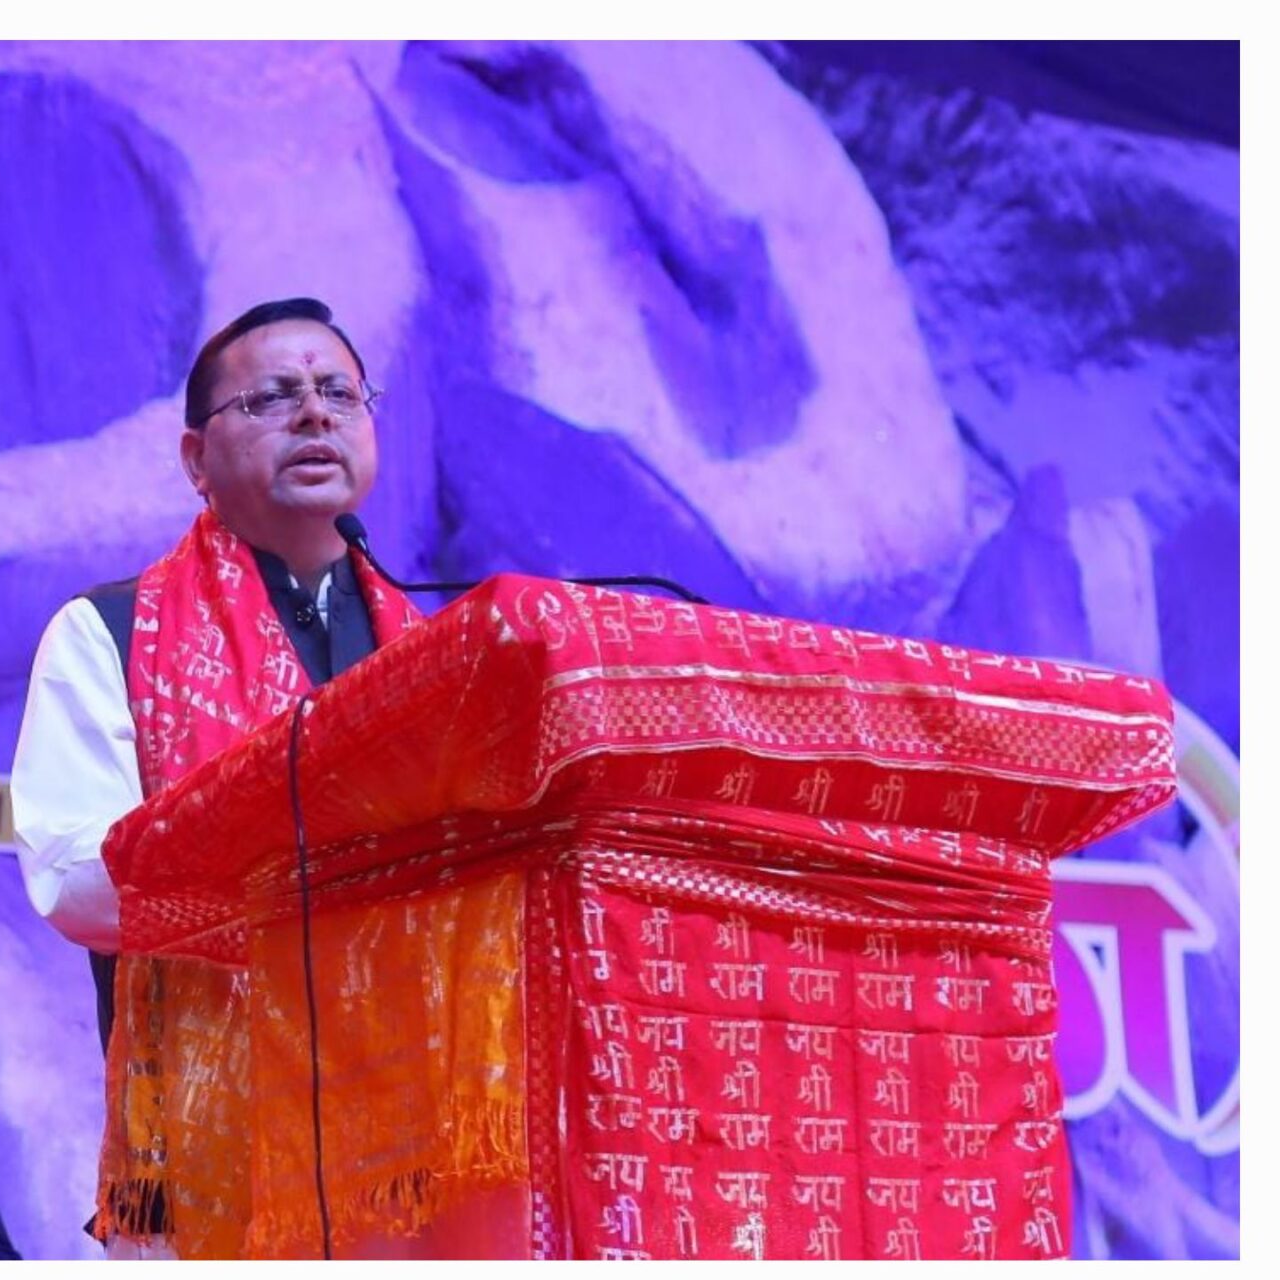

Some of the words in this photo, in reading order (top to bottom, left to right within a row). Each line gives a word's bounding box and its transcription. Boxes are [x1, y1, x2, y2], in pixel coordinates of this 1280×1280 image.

[792, 767, 834, 814] श्री
[866, 775, 907, 821] श्री
[638, 959, 687, 998] राम
[710, 963, 768, 1001] राम
[787, 967, 840, 1007] राम
[857, 973, 915, 1011] राम
[936, 977, 991, 1015] राम
[637, 1016, 689, 1052] जय
[710, 1020, 763, 1057] जय
[786, 1023, 838, 1061] जय
[858, 1029, 914, 1064] जय
[645, 1055, 685, 1102] श्री
[721, 1060, 761, 1108] श्री
[798, 1064, 832, 1111] श्री
[875, 1067, 910, 1115] श्री
[948, 1071, 980, 1118] श्री
[647, 1107, 700, 1145] राम
[718, 1112, 772, 1151] राम
[796, 1117, 848, 1154] राम
[869, 1119, 922, 1157] राम
[943, 1123, 999, 1160] राम
[715, 1172, 771, 1209] जय
[792, 1175, 846, 1213] जय
[866, 1177, 920, 1213] जय
[943, 1179, 997, 1214] जय
[595, 1194, 644, 1245] श्री
[807, 1216, 842, 1260] श्री
[885, 1217, 920, 1260] श्री
[1023, 1207, 1063, 1254] श्री
